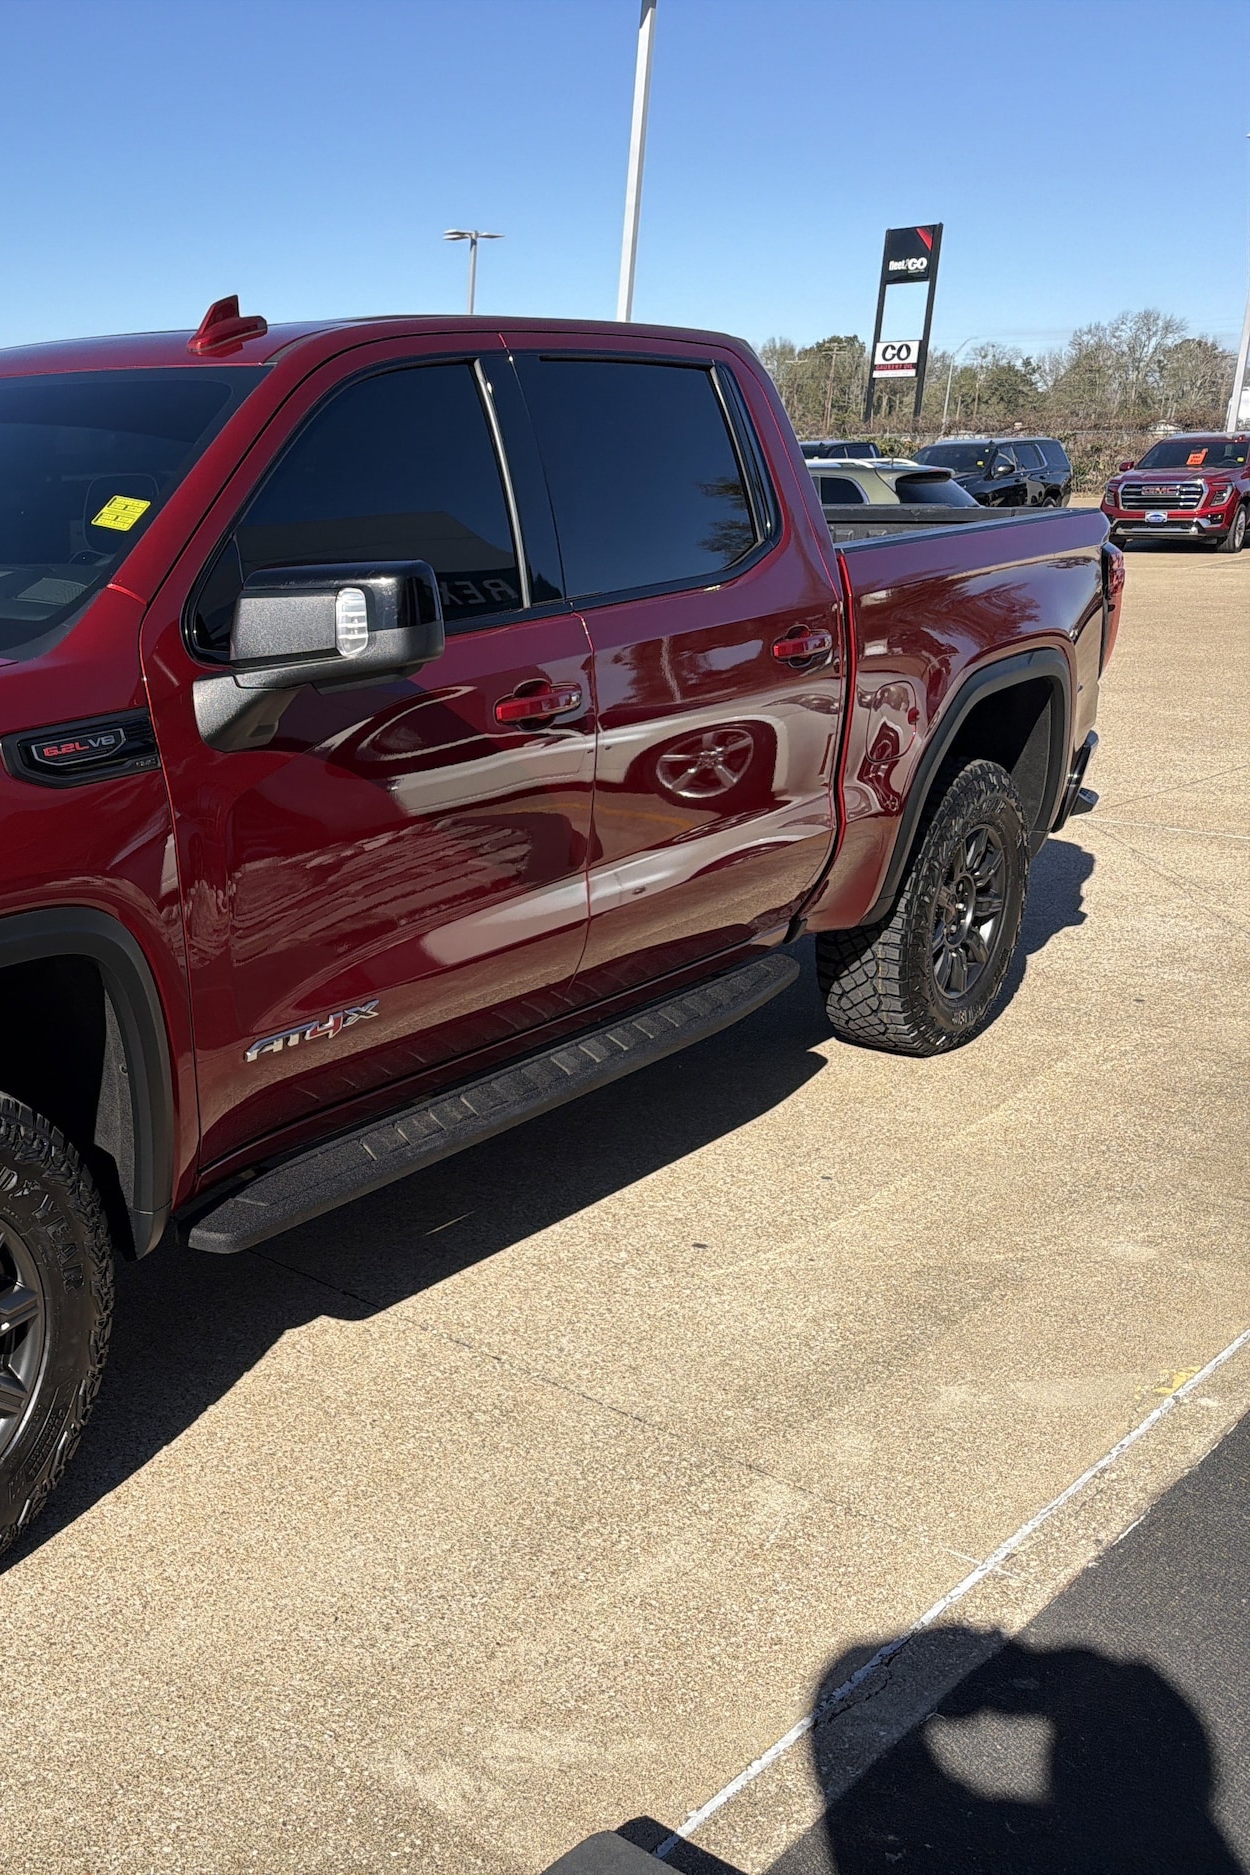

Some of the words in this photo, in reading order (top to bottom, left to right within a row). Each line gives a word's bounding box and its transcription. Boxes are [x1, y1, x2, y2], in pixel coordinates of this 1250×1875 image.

[882, 343, 911, 362] GO
[1141, 485, 1177, 495] GMC
[244, 999, 380, 1063] AT4X
